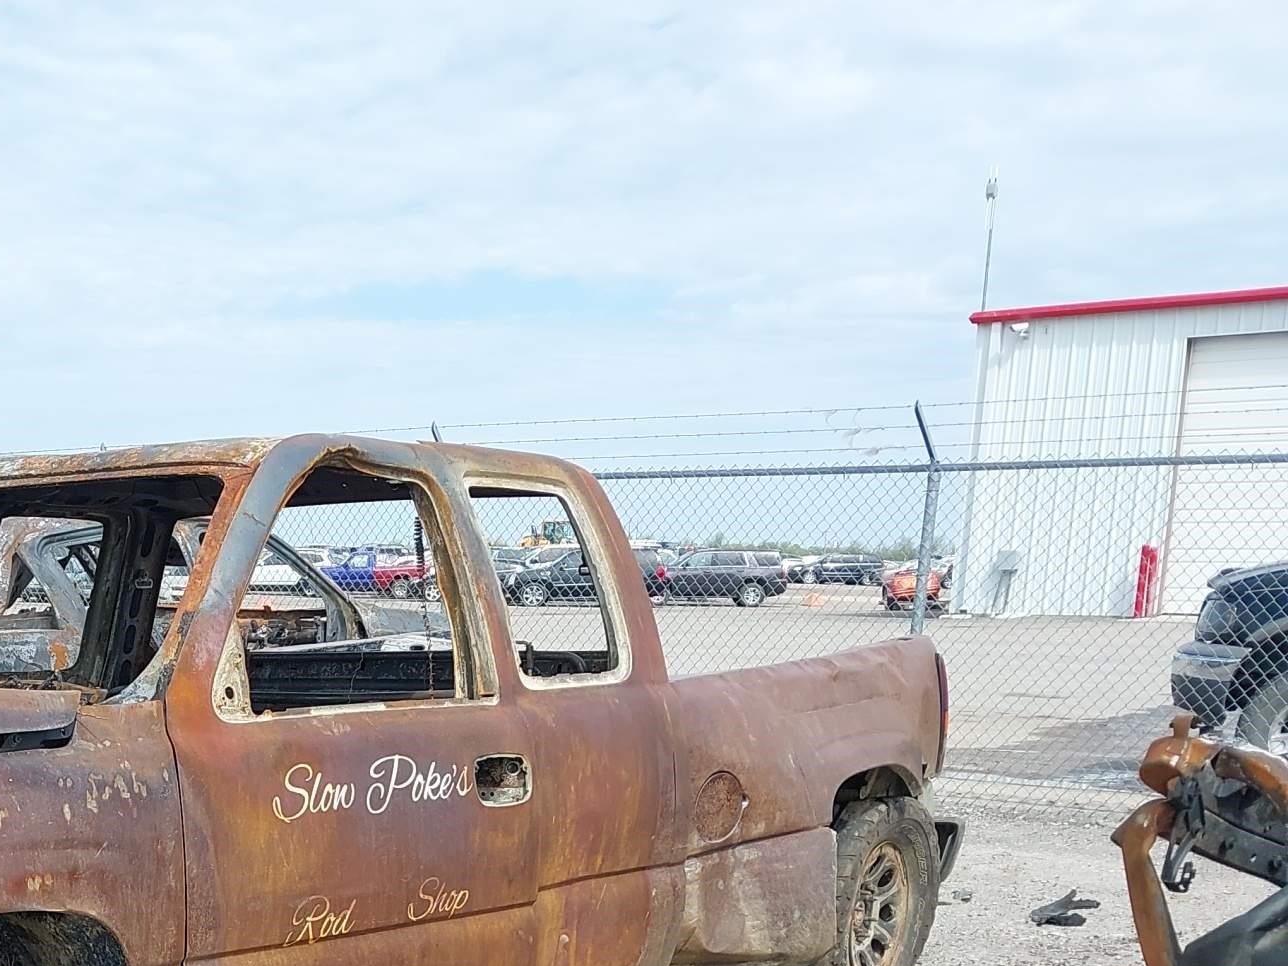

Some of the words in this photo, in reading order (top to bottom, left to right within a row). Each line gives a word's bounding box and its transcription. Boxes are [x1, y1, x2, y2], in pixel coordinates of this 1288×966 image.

[273, 763, 356, 824] Slow
[366, 754, 473, 815] Poke's
[283, 895, 357, 947] Rod
[407, 876, 470, 922] Shop
